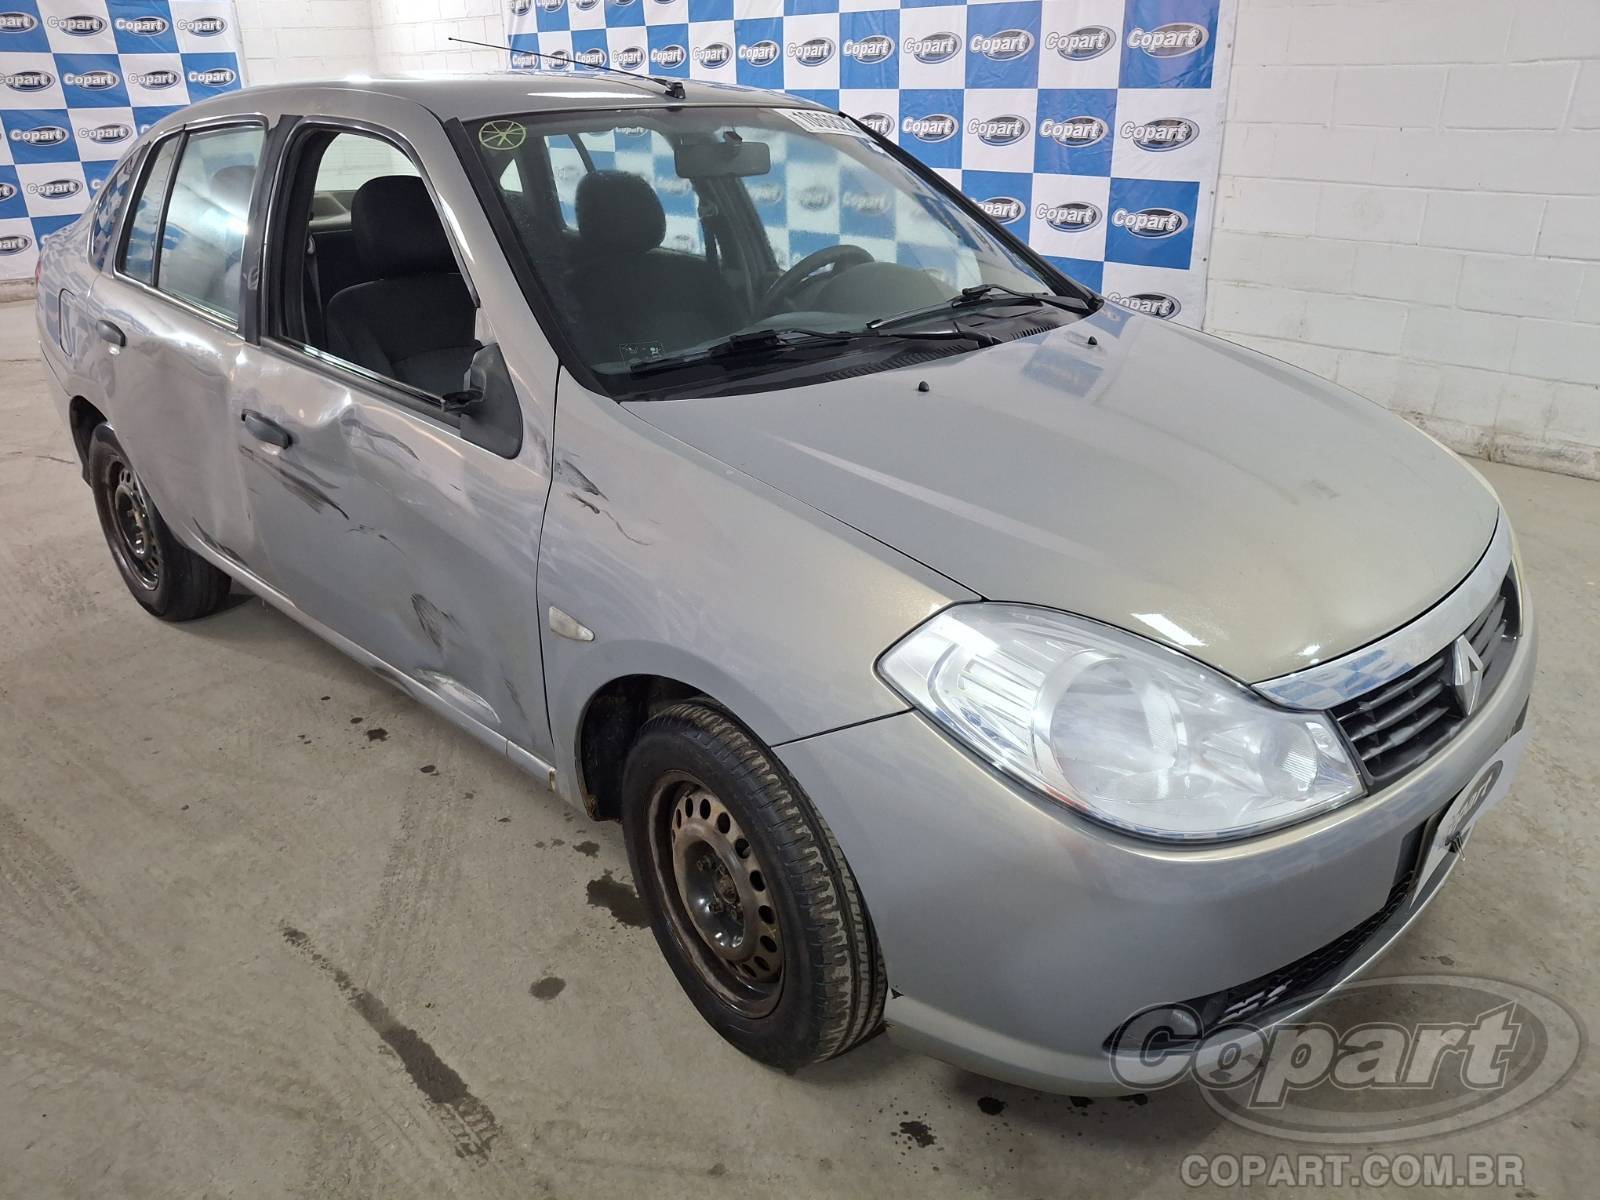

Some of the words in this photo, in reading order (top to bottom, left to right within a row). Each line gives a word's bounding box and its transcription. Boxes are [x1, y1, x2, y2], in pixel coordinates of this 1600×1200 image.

[0, 18, 31, 28] part
[47, 16, 99, 31] Copart
[115, 18, 163, 33] Copart
[177, 18, 222, 32] Copart
[904, 37, 954, 57] Copart
[970, 32, 1026, 55] Copart
[1045, 29, 1107, 54] Copart
[1127, 27, 1200, 52] Copart
[651, 48, 683, 63] Copart
[692, 47, 728, 61] Copart
[738, 44, 775, 60] Copart
[787, 42, 829, 60] Copart
[842, 39, 889, 59] Copart
[512, 54, 536, 67] Copart
[575, 52, 603, 65] Copart
[612, 52, 642, 63] Copart
[64, 73, 114, 88] Copart
[128, 73, 174, 86] Copart
[189, 71, 232, 84] Copart
[79, 127, 126, 140] Copart
[902, 116, 952, 136] Copart
[968, 118, 1021, 139] Copart
[1040, 118, 1099, 141] Copart
[1120, 120, 1190, 144] Copart
[10, 128, 62, 143] Copart
[27, 182, 77, 195] Copart
[978, 202, 1018, 218] opart
[1035, 203, 1094, 225] Copart
[1112, 208, 1178, 231] Copart
[0, 236, 26, 249] art
